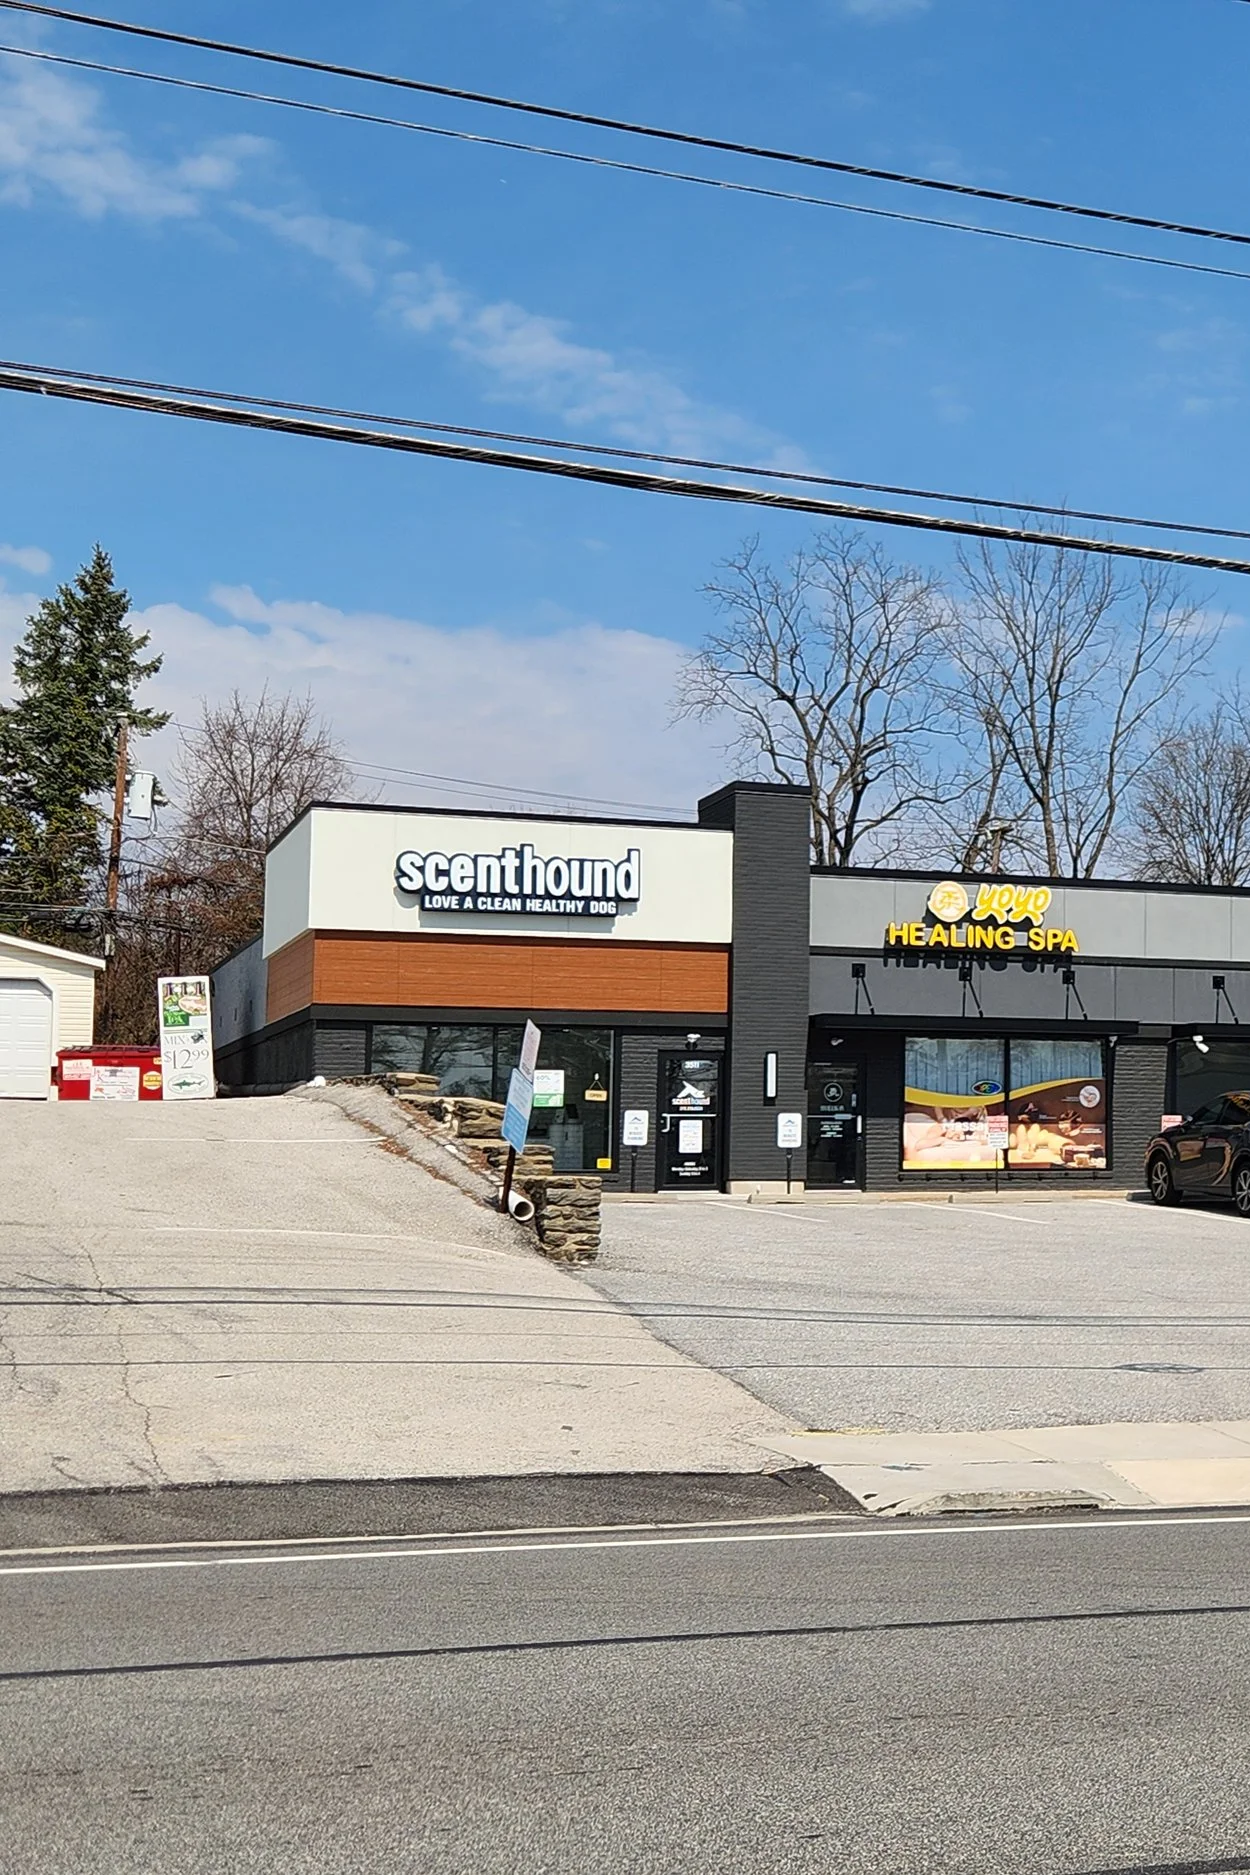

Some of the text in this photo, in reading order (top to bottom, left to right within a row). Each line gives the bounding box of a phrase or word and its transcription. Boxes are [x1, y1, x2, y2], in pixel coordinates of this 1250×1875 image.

[397, 844, 641, 899] scenthound
[424, 894, 617, 915] LOVE A CLEAN HEALTHY DOG
[888, 922, 1080, 953] HEALING SPA
